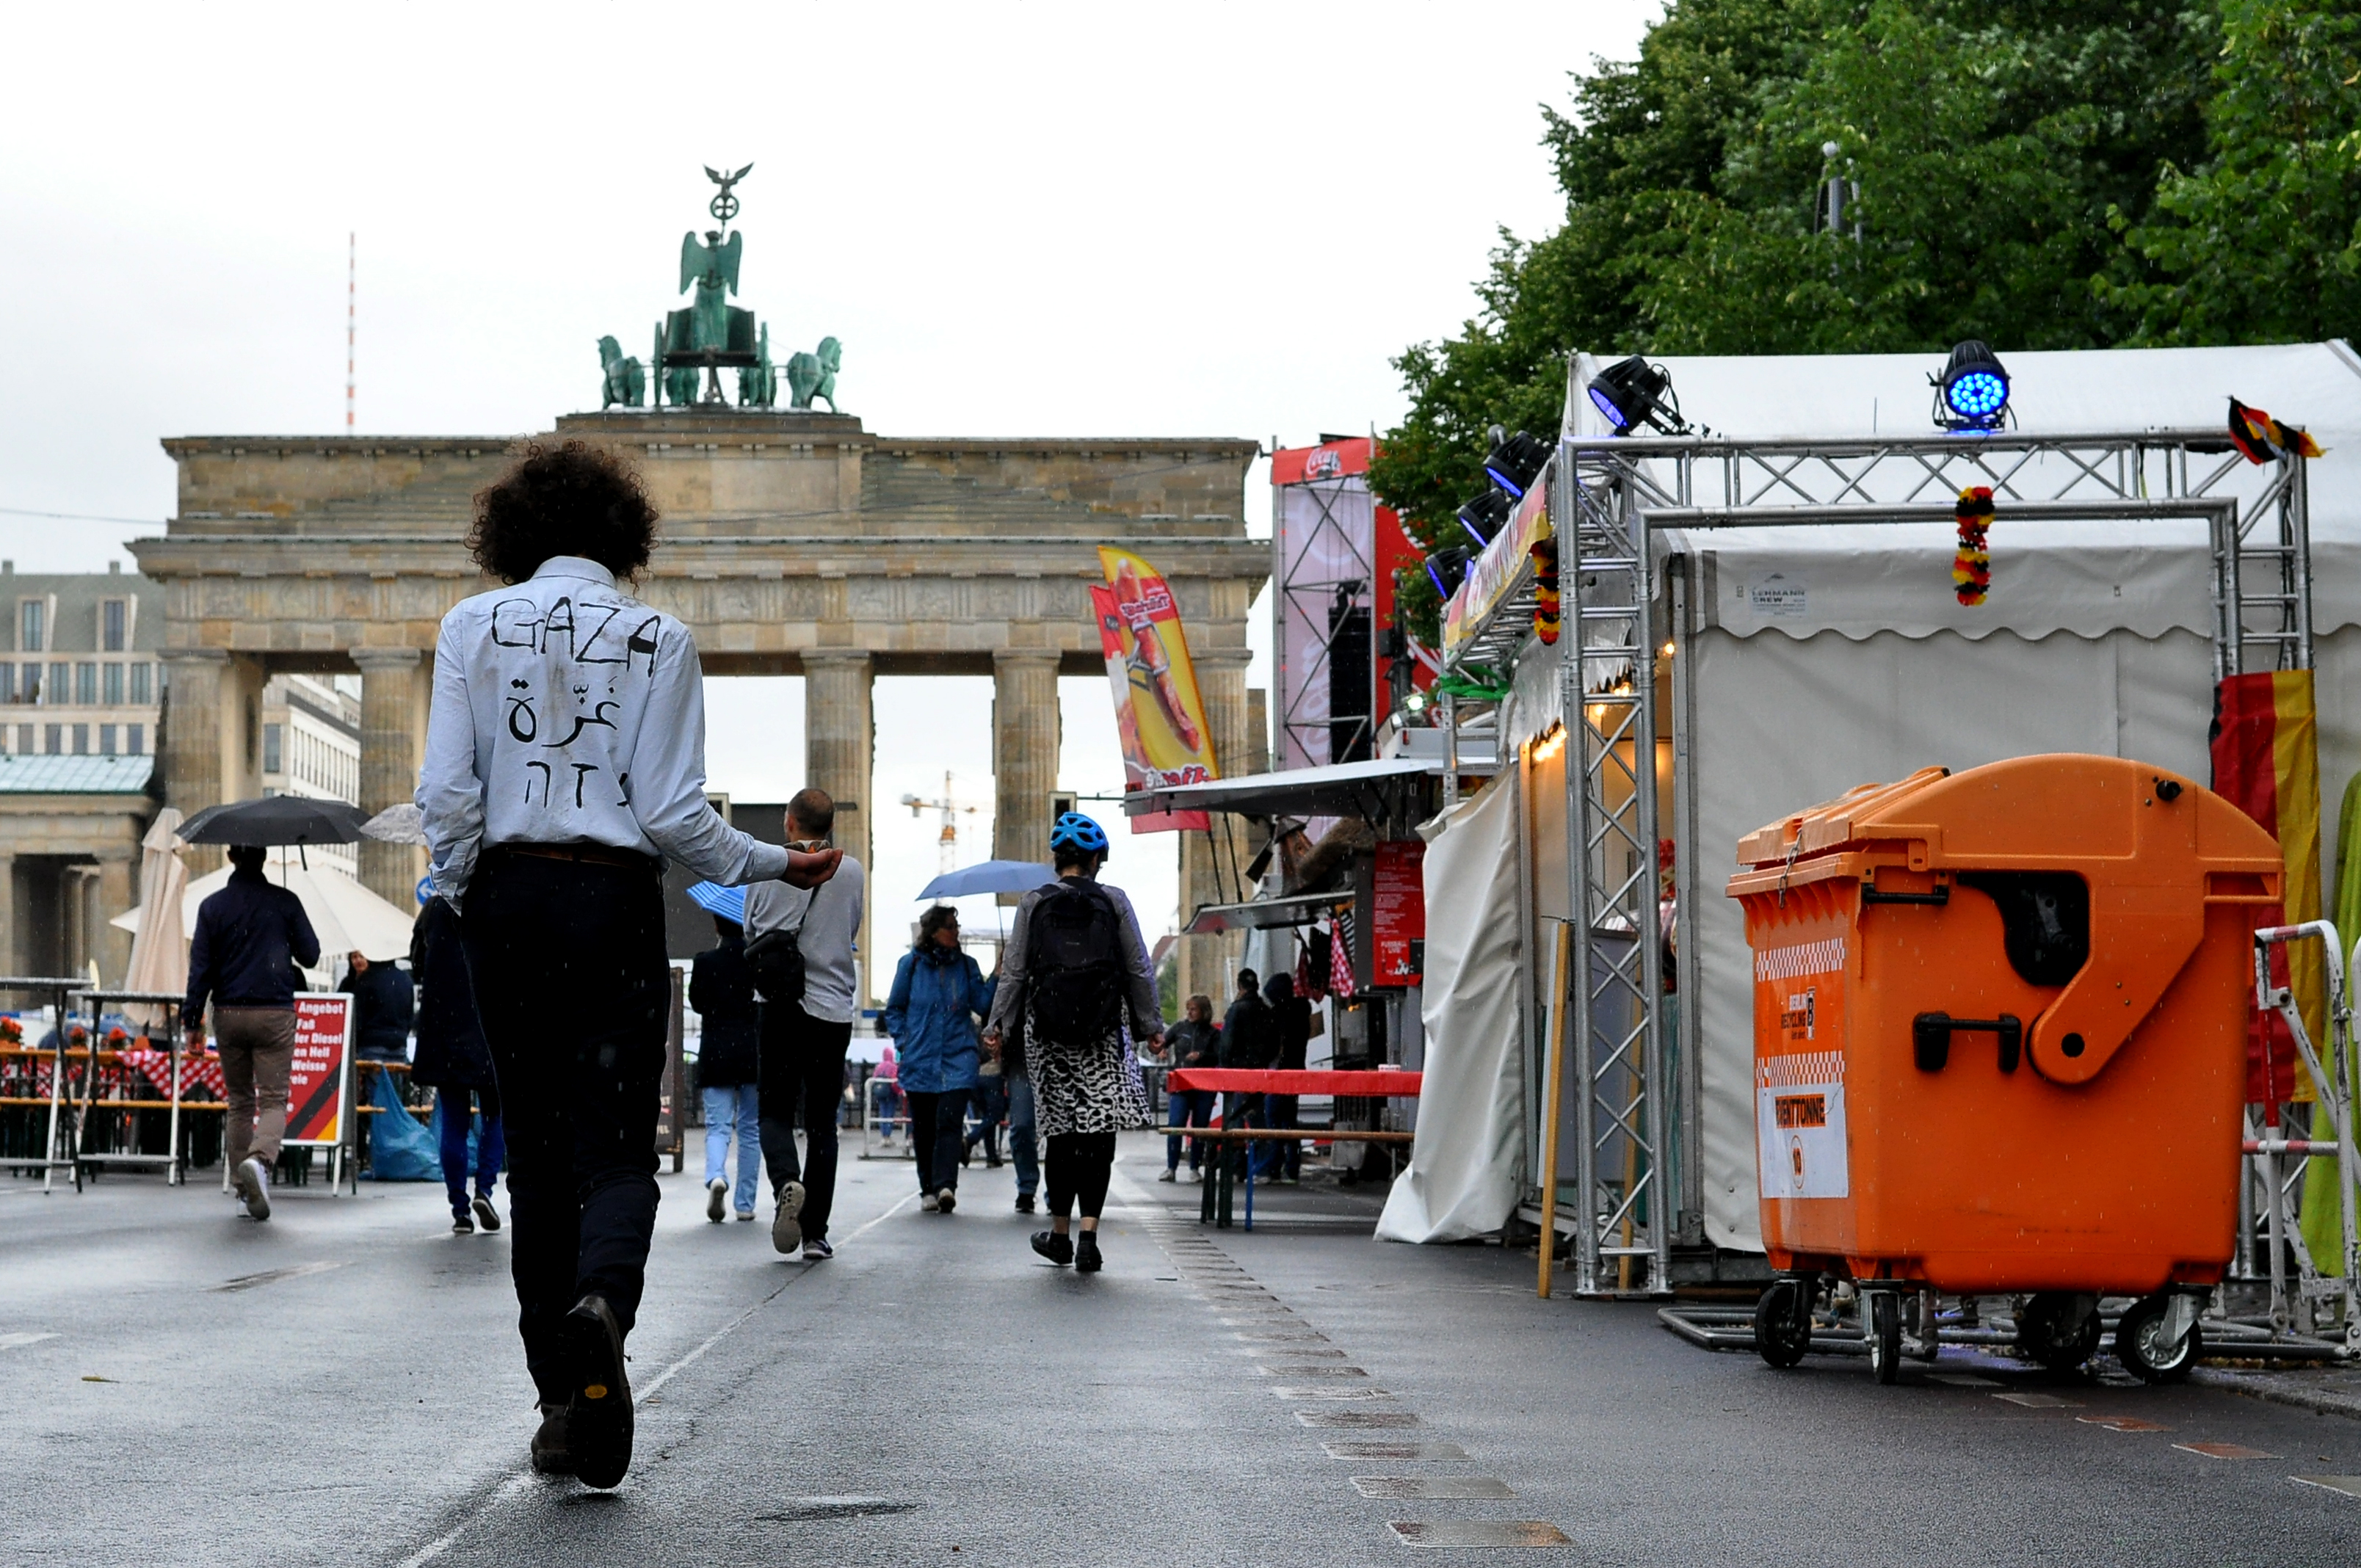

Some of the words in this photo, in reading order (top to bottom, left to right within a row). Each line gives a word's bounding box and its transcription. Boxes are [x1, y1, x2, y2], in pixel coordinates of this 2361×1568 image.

[491, 596, 661, 678] GAZA
[298, 1001, 344, 1017] Angebot
[311, 1032, 342, 1045] Diesel
[309, 1046, 330, 1058] Hell
[291, 1059, 327, 1072] Weisse
